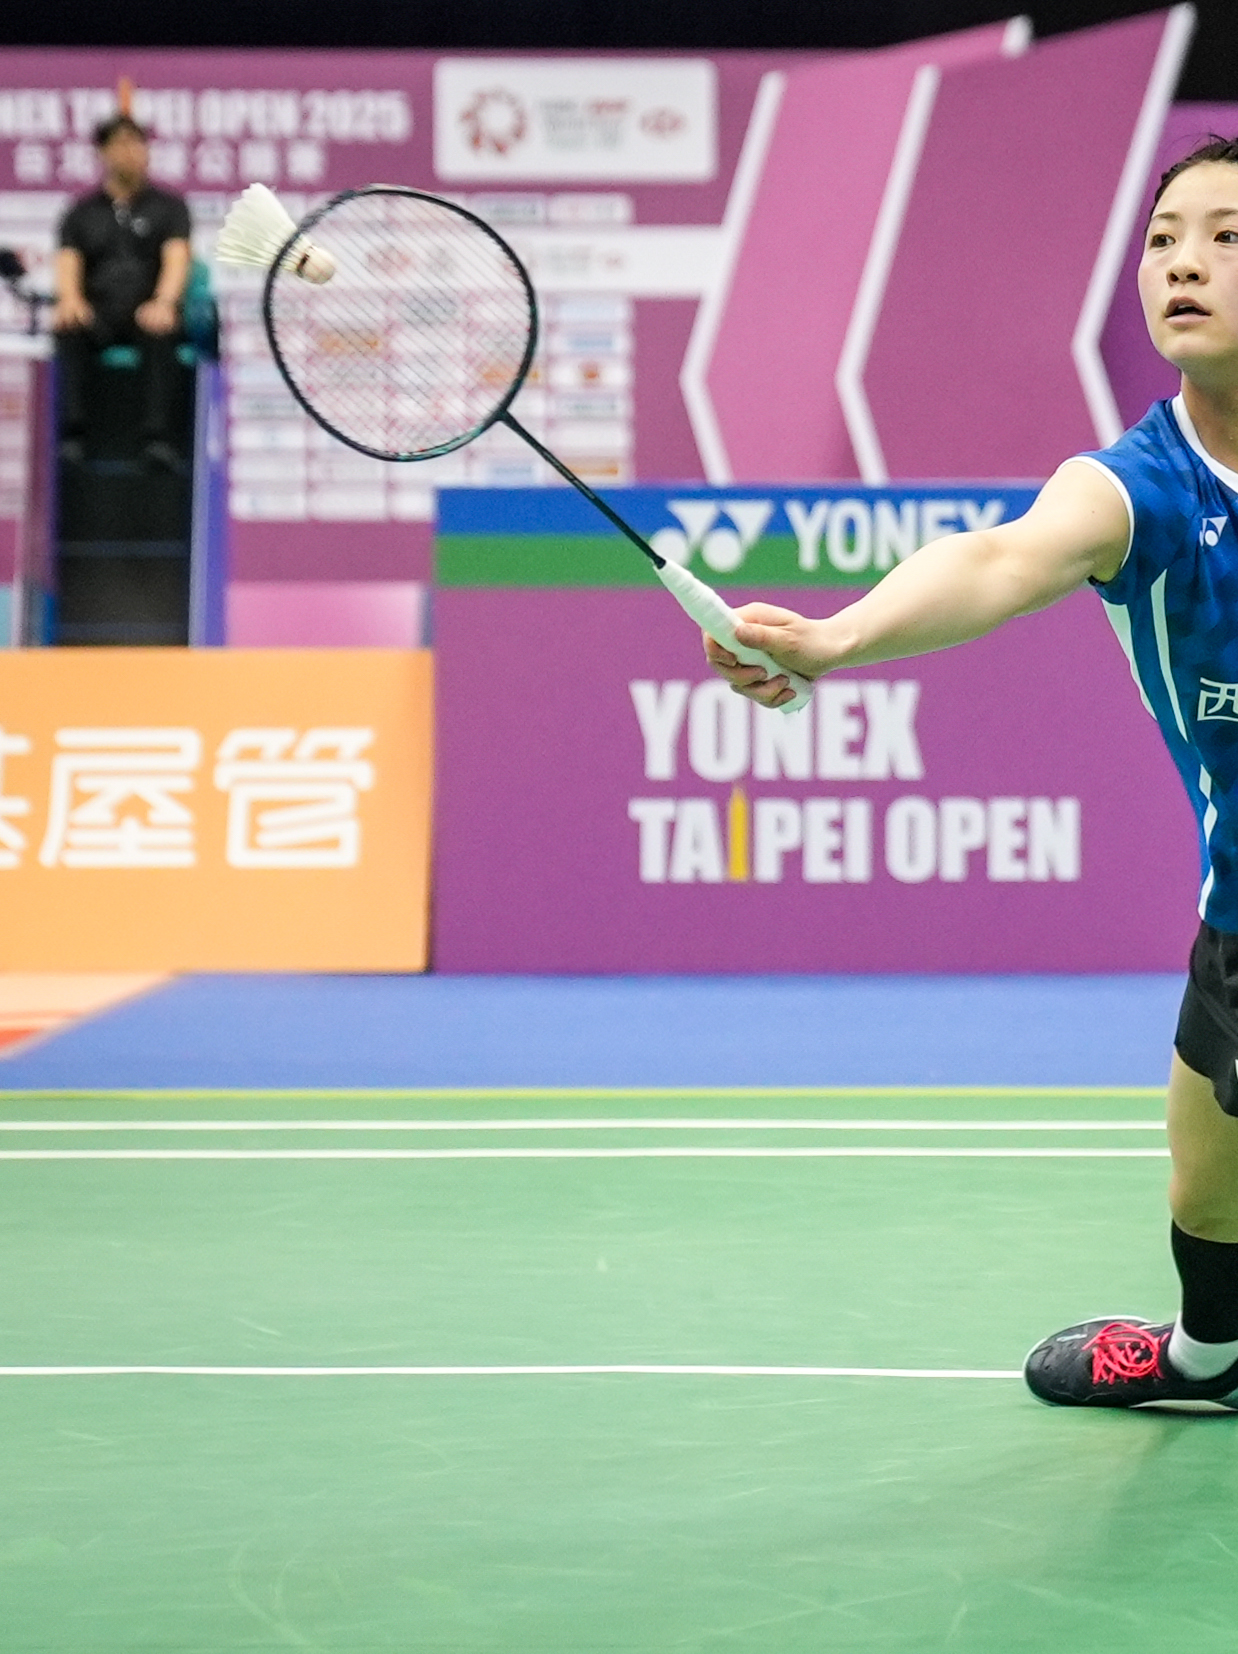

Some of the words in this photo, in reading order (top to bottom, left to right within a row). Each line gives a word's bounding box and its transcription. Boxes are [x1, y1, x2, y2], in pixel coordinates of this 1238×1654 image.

[198, 89, 299, 139] OPEN
[302, 89, 412, 142] 2025
[629, 679, 925, 781] YONEX
[0, 726, 375, 869] 屋管
[628, 786, 873, 884] TAIPEI
[884, 796, 1082, 884] OPEN
